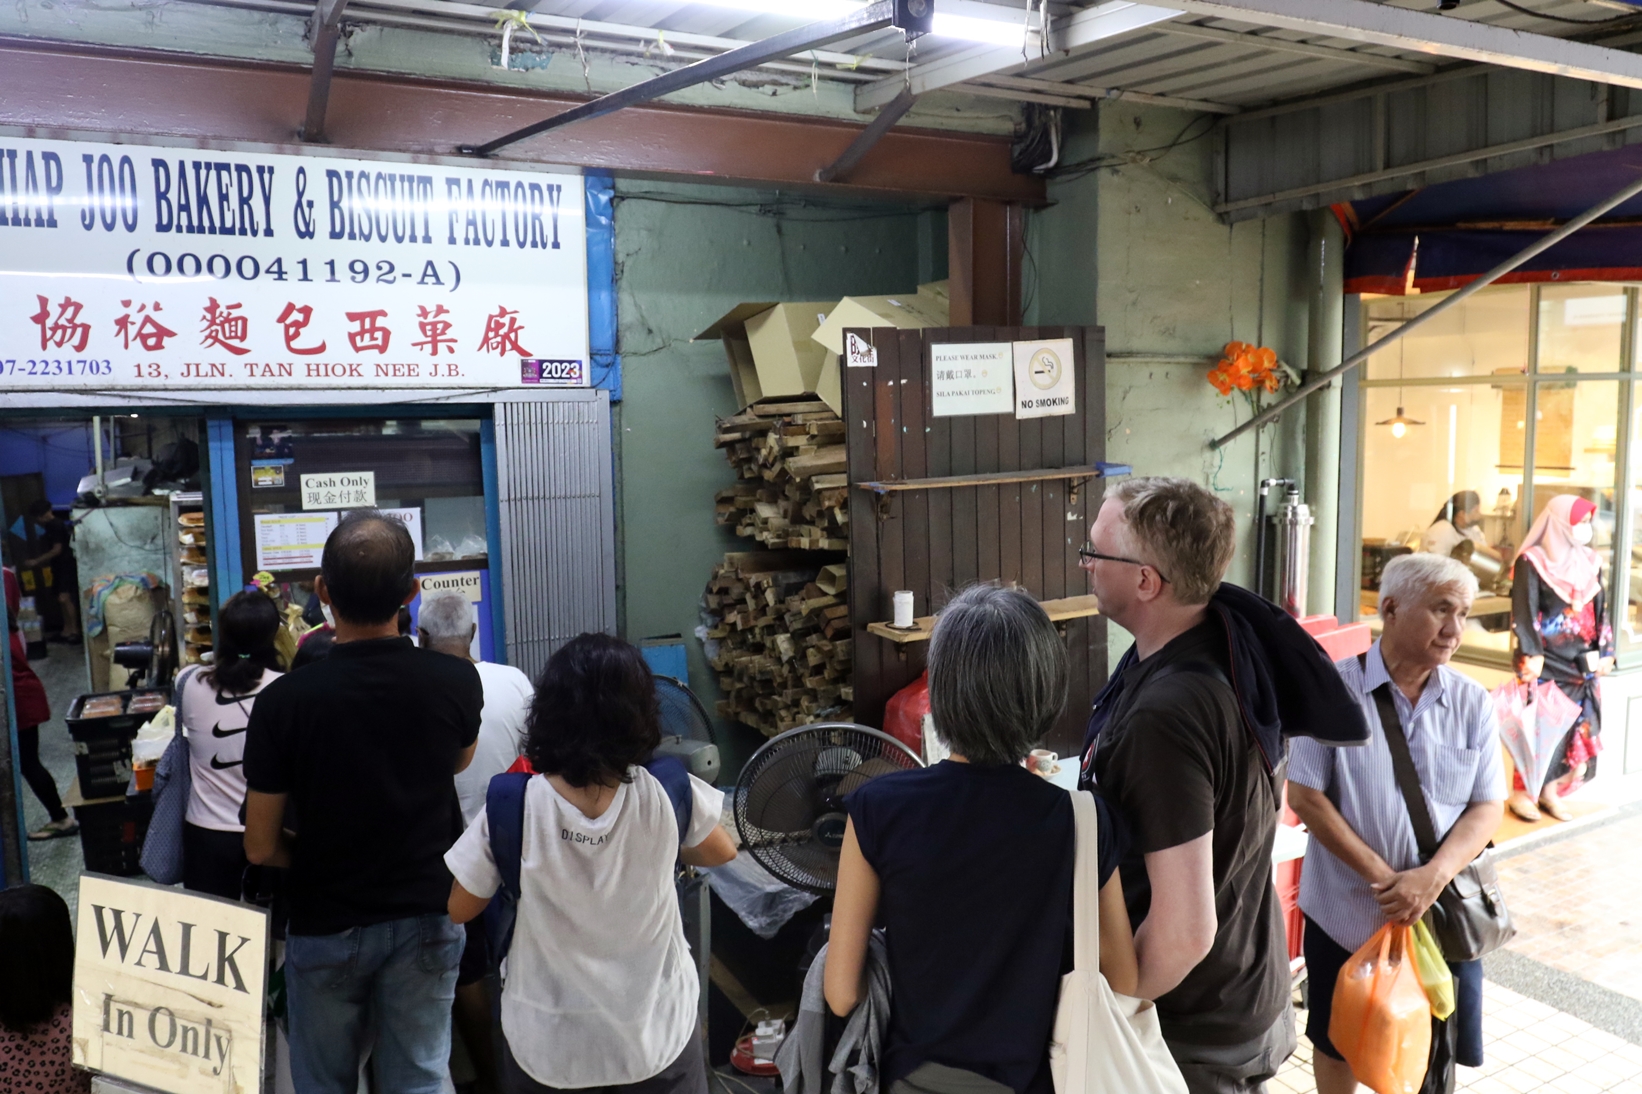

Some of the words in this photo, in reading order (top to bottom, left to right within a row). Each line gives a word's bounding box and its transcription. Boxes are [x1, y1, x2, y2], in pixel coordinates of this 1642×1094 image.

[81, 153, 138, 233] JOO
[151, 158, 275, 237] BAKERY
[293, 165, 316, 240] &
[326, 168, 433, 244] BISCUIT
[445, 176, 562, 250] FACTORY
[126, 248, 461, 292] (000041192-A)
[134, 362, 168, 380] 13,
[180, 363, 233, 378] JLN.
[244, 363, 293, 377] TAN
[305, 363, 363, 377] HIOK
[375, 363, 420, 377] NEE
[429, 363, 465, 378] J.B.
[542, 362, 580, 378] 2023
[1021, 399, 1034, 409] NO
[1035, 396, 1069, 408] SMOKING
[305, 477, 336, 489] Cash
[340, 476, 370, 489] Only
[307, 489, 368, 506] 现金付款
[421, 576, 480, 591] Counter
[561, 828, 609, 845] DISPLAY
[91, 903, 251, 995] WALK
[101, 992, 135, 1040] In
[147, 1005, 232, 1076] Only
